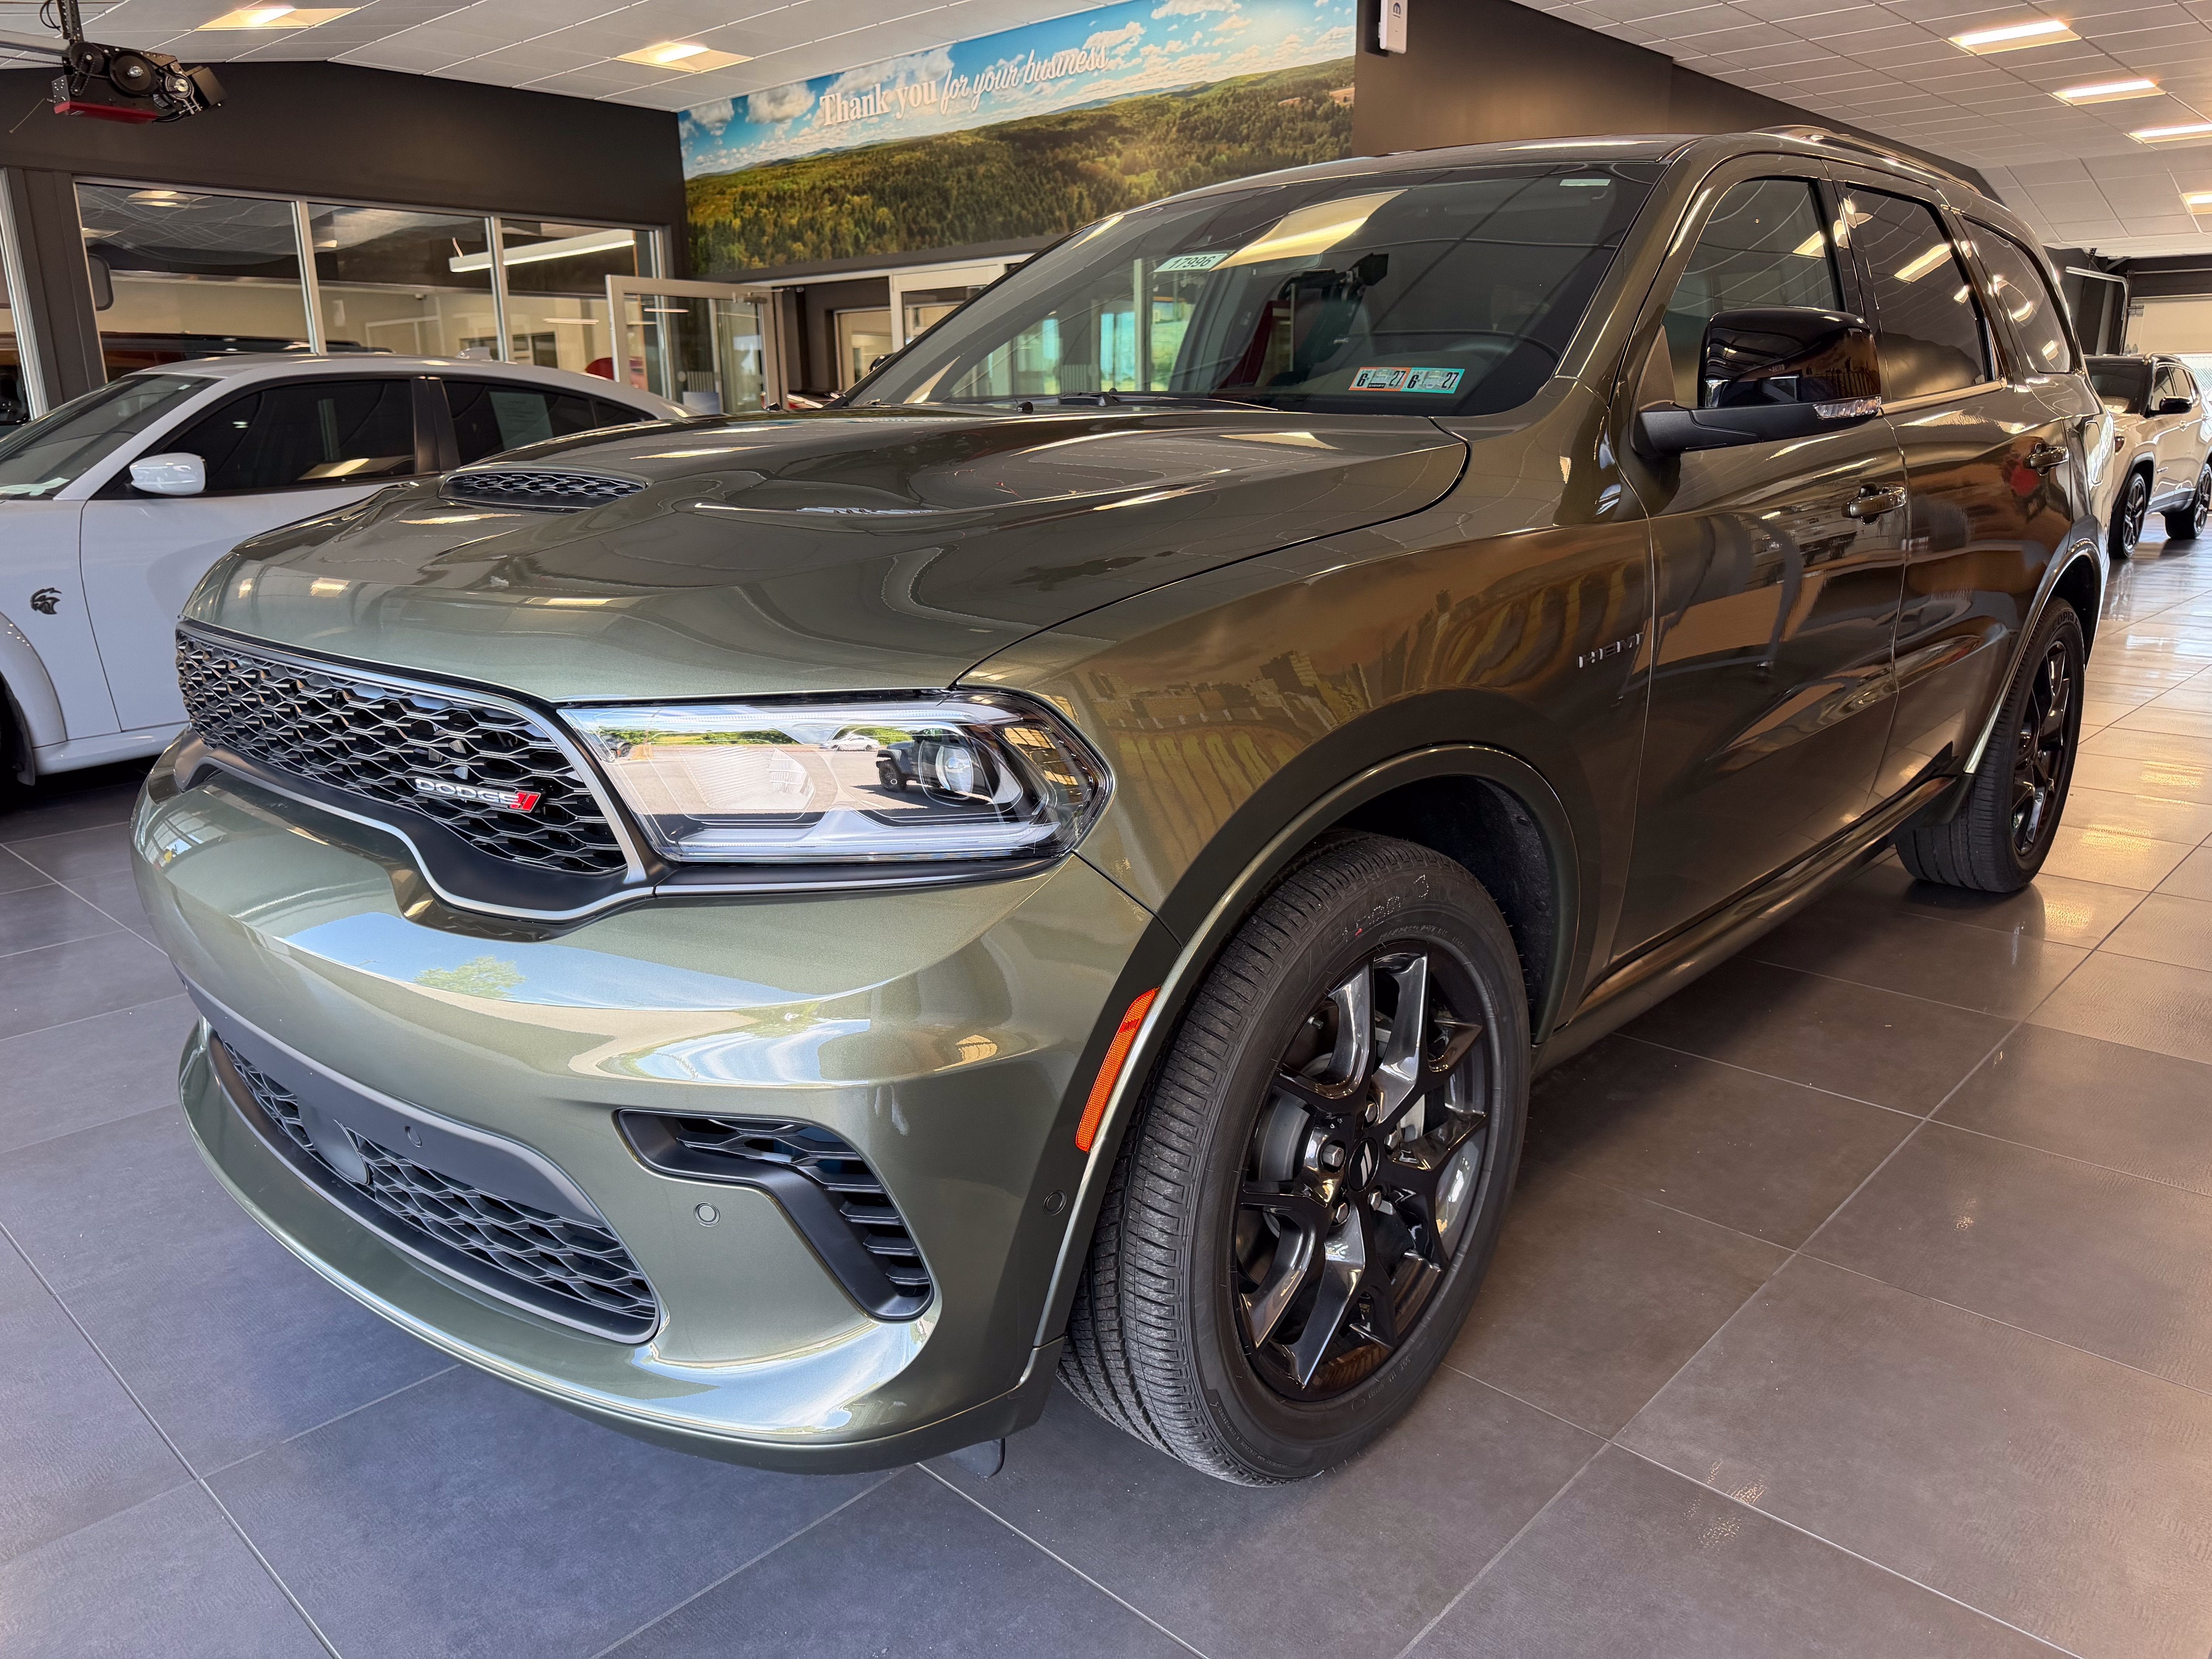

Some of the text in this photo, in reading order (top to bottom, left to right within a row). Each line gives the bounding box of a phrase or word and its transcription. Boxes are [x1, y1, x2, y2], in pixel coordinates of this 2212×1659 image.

[819, 45, 1109, 126] Thank you for your business
[1168, 256, 1216, 269] 17996
[1356, 370, 1406, 387] 6 27
[1407, 372, 1459, 388] 6 27
[415, 778, 521, 808] DODGE
